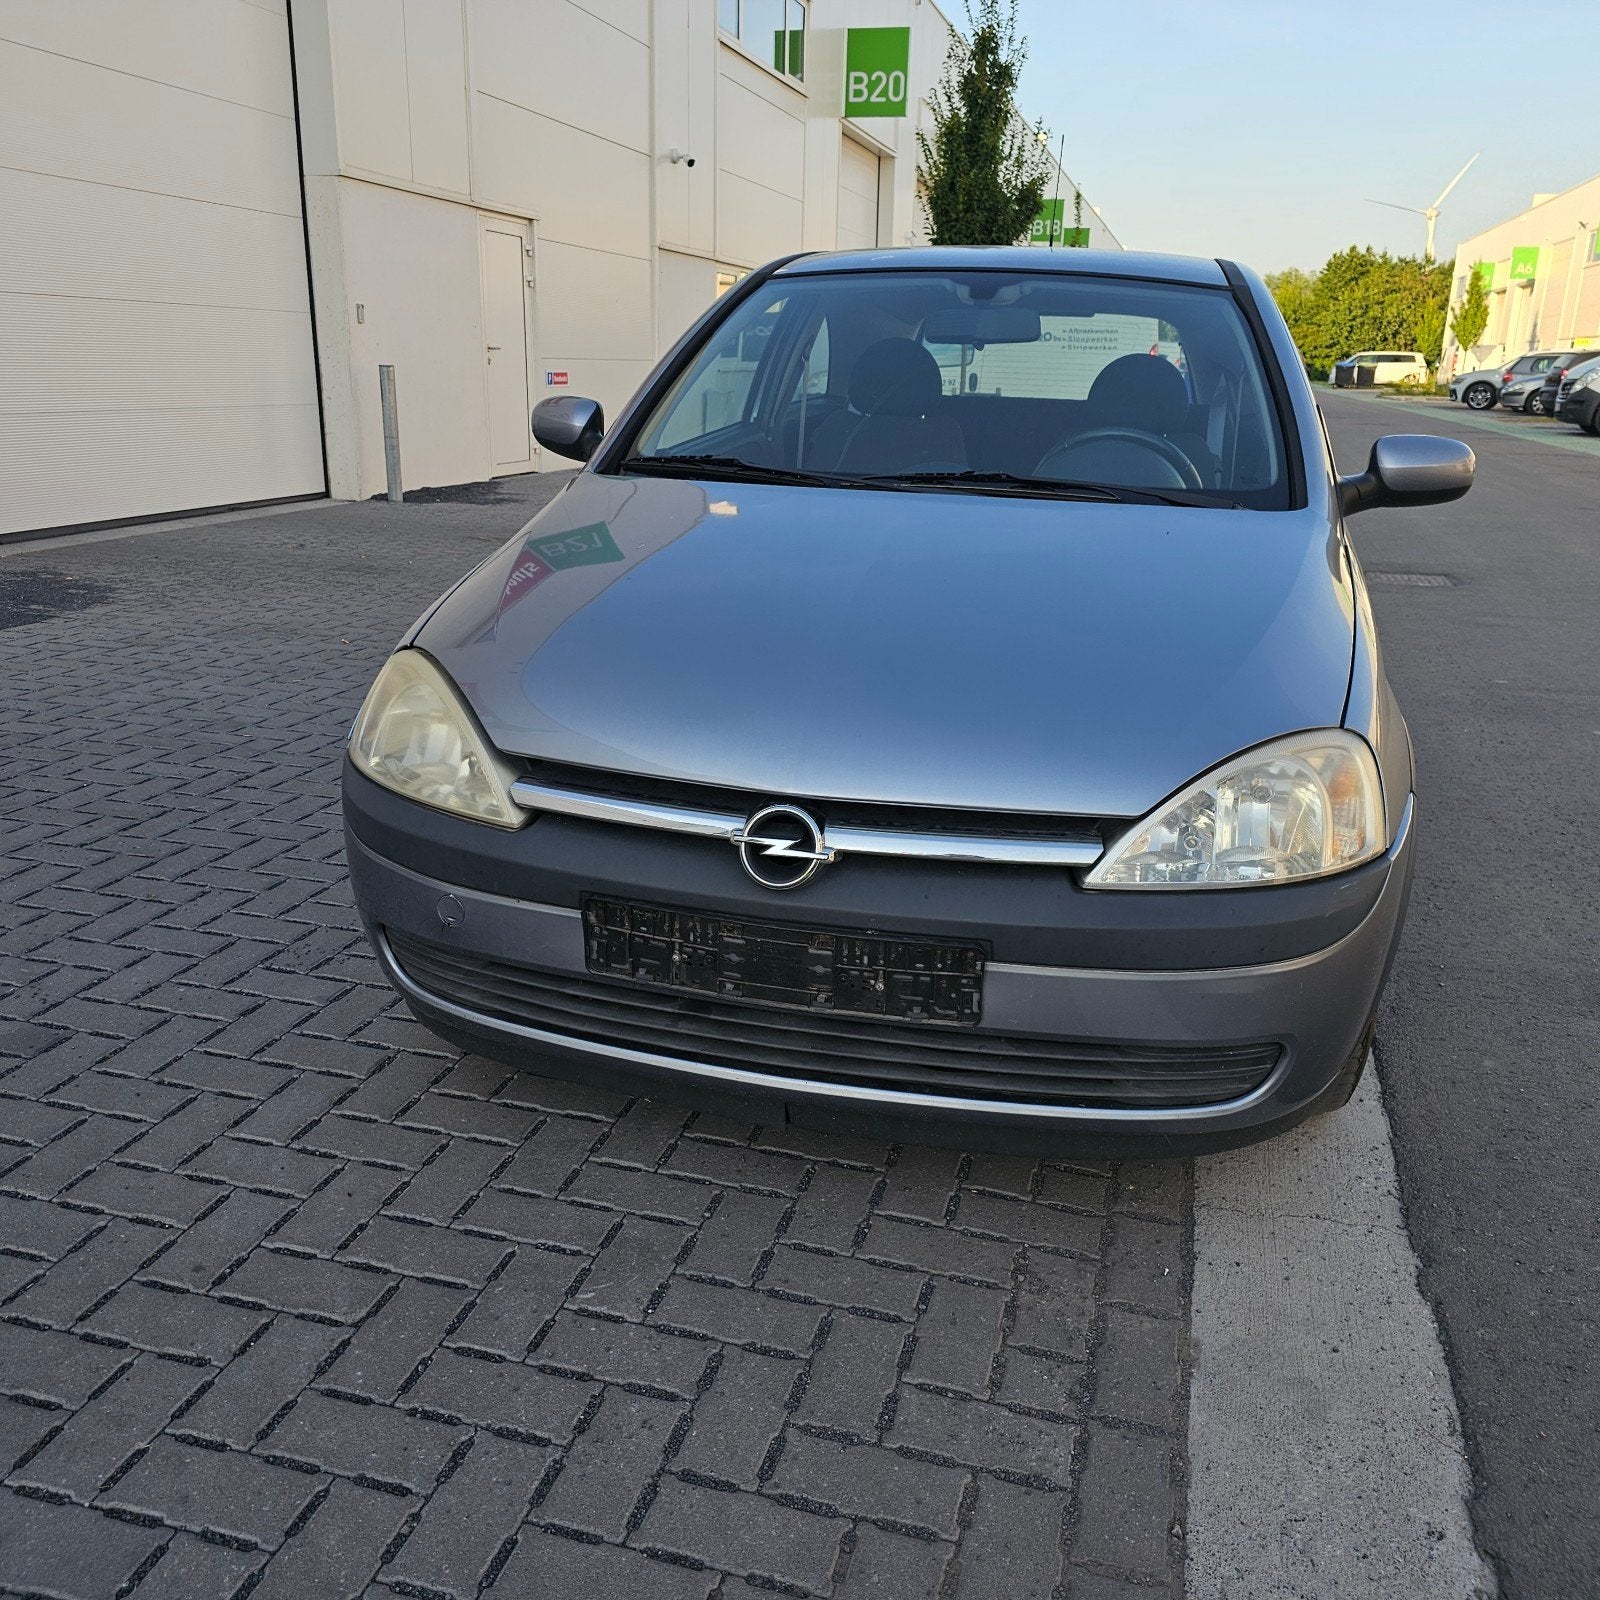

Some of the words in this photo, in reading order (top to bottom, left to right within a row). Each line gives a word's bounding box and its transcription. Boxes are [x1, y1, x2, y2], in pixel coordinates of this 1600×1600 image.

[848, 70, 906, 103] B20
[1032, 219, 1061, 236] B18
[1515, 262, 1533, 275] A6
[1067, 336, 1118, 344] Sloopwerken
[1067, 344, 1118, 352] Stripwerken
